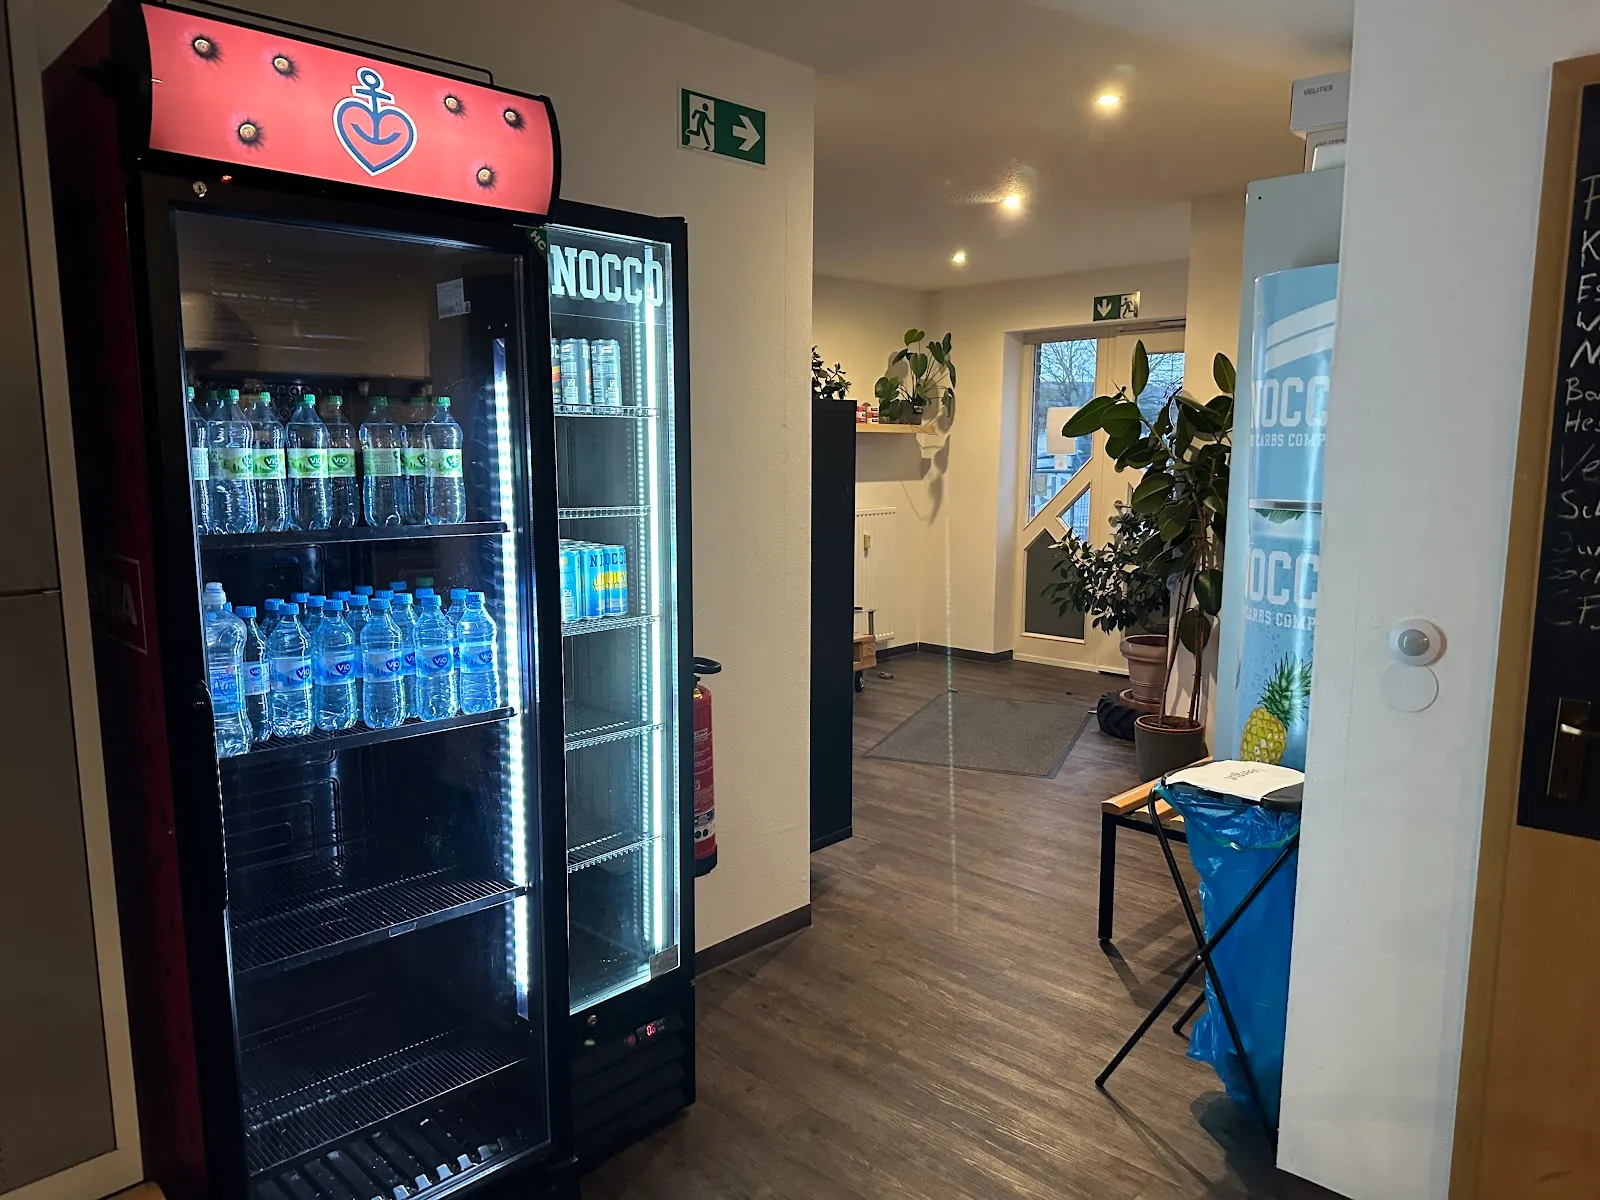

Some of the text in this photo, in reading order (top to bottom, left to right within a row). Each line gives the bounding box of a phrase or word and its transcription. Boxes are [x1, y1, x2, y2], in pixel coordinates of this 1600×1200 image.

[1303, 84, 1334, 96] VELITES
[550, 244, 663, 307] NOCCO
[1250, 376, 1330, 429] NOCC
[1287, 433, 1327, 447] COMP
